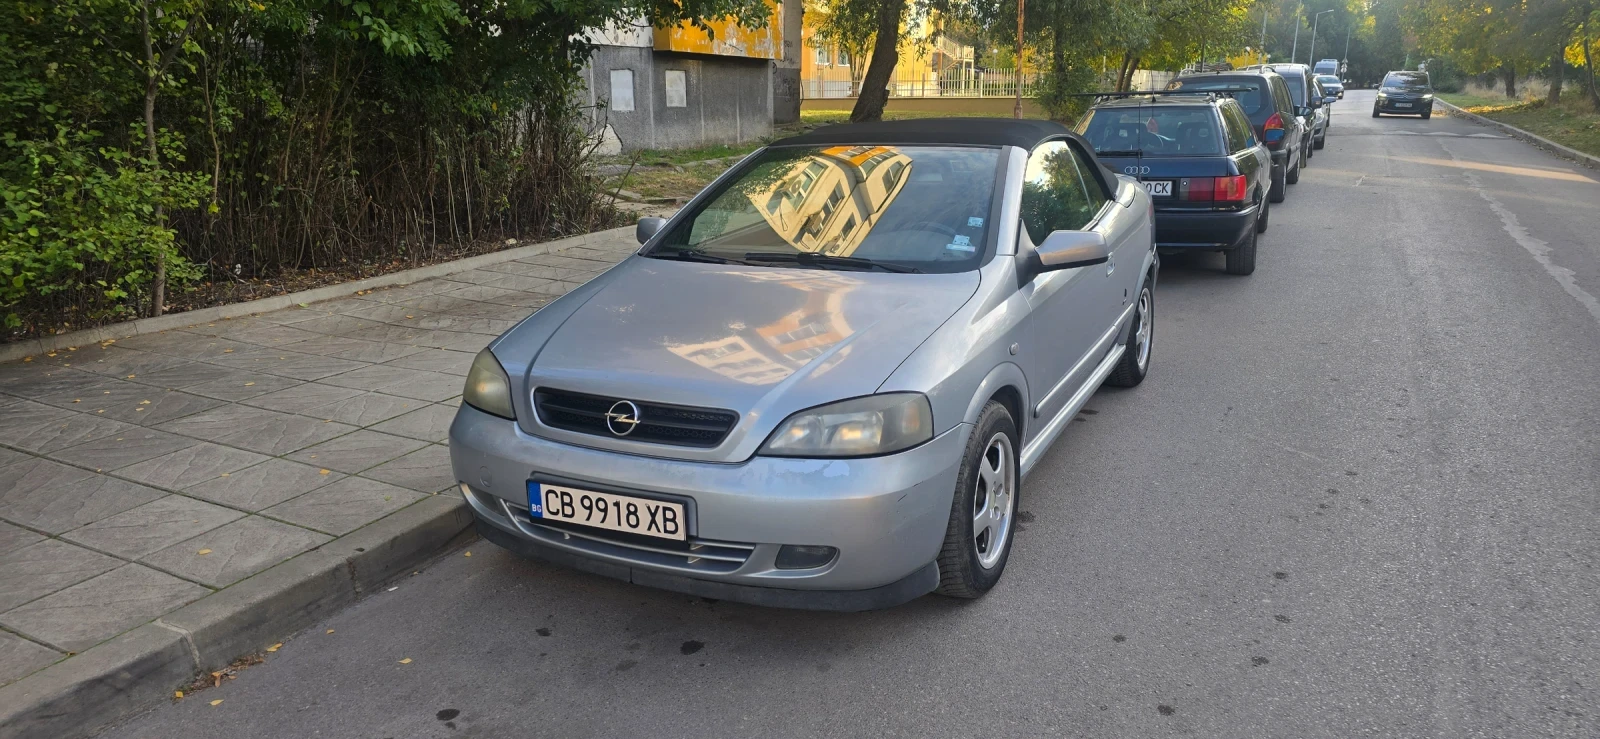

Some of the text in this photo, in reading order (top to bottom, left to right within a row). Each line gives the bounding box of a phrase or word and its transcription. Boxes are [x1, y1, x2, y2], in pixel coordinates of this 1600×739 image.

[1154, 183, 1169, 193] CK
[532, 489, 679, 535] BG CB 9918 XB
